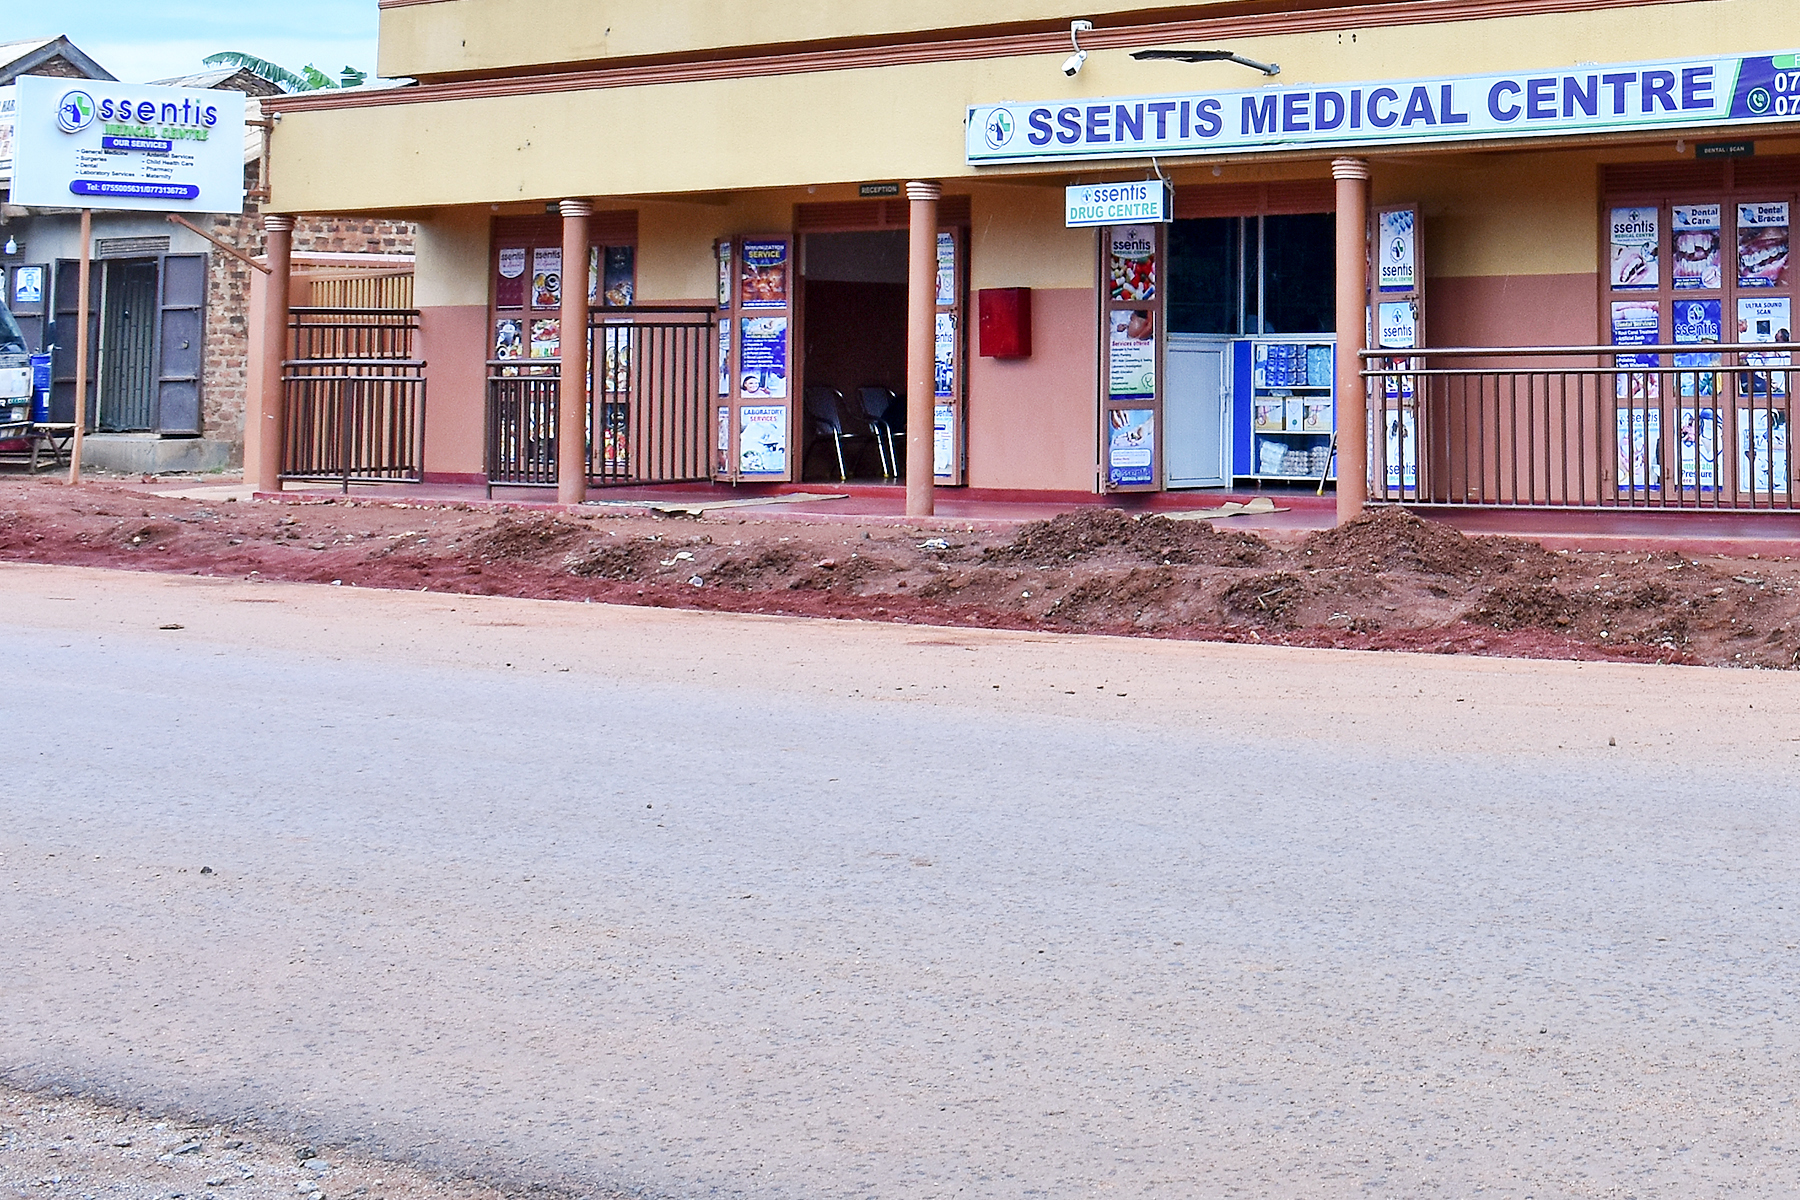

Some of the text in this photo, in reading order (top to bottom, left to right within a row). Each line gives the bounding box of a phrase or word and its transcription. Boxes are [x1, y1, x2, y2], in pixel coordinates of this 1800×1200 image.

[1028, 66, 1714, 145] SSENTIS MEDICAL CENTRE
[101, 98, 218, 126] ssentis
[104, 123, 209, 140] MEDICAL CENTRE
[112, 138, 168, 149] OUR SERVICES
[86, 183, 100, 191] Tel:
[861, 185, 898, 194] RECEPTION
[1094, 184, 1147, 203] ssentis
[1070, 202, 1158, 220] DRUG CENTRE
[1691, 208, 1718, 217] Dental
[1758, 205, 1783, 214] Dental
[1691, 217, 1711, 225] Care
[1757, 215, 1784, 223] Braces
[1613, 221, 1655, 234] ssentis
[1113, 239, 1151, 250] ssentis
[748, 250, 781, 258] SERVICE
[1383, 263, 1413, 277] ssentis
[1383, 324, 1413, 337] ssentis
[1675, 320, 1718, 335] ssentis
